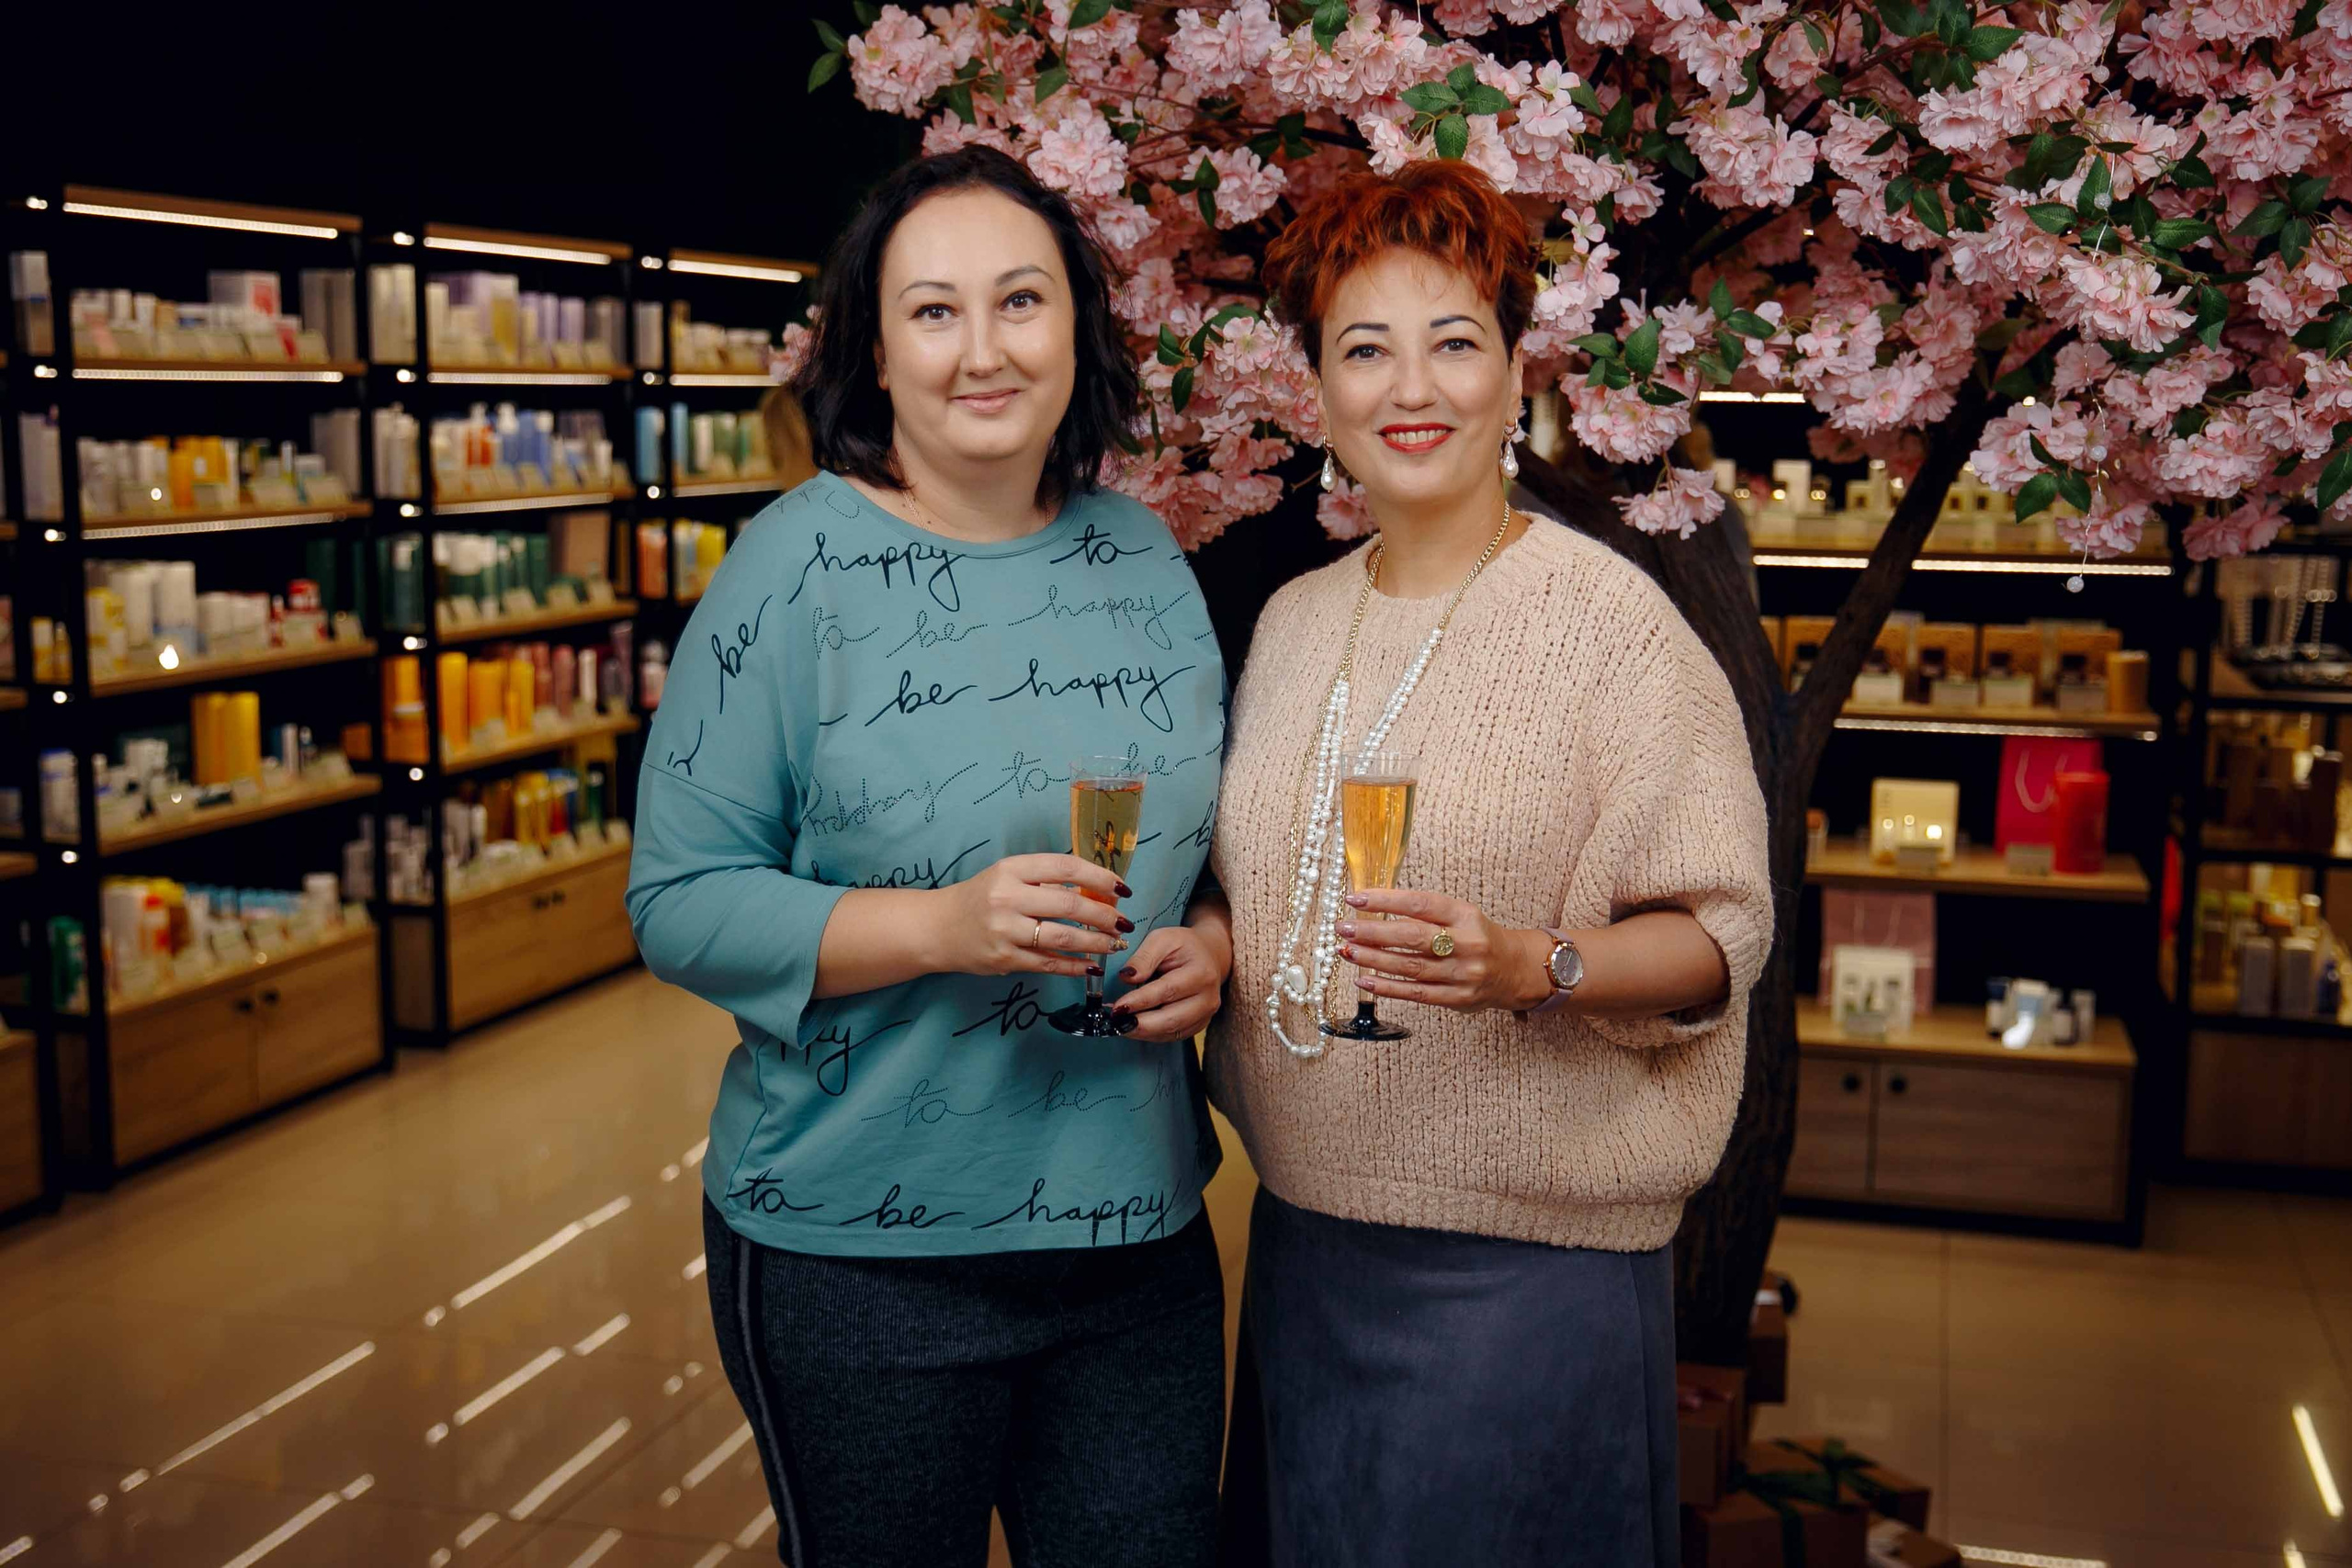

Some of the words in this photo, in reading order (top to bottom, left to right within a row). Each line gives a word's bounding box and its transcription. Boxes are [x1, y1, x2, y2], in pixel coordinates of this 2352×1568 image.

[711, 594, 774, 715] be
[788, 532, 967, 612] happy
[1050, 524, 1154, 566] to
[812, 606, 881, 660] to
[886, 610, 989, 659] be
[1008, 584, 1191, 650] happy
[865, 670, 978, 727] be
[988, 659, 1197, 733] happy
[973, 750, 1071, 805] to
[952, 981, 1047, 1037] to
[860, 1078, 995, 1129] to
[1007, 1069, 1128, 1118] be
[726, 1167, 825, 1213] to
[839, 1183, 967, 1229] be
[971, 1178, 1183, 1247] happy
